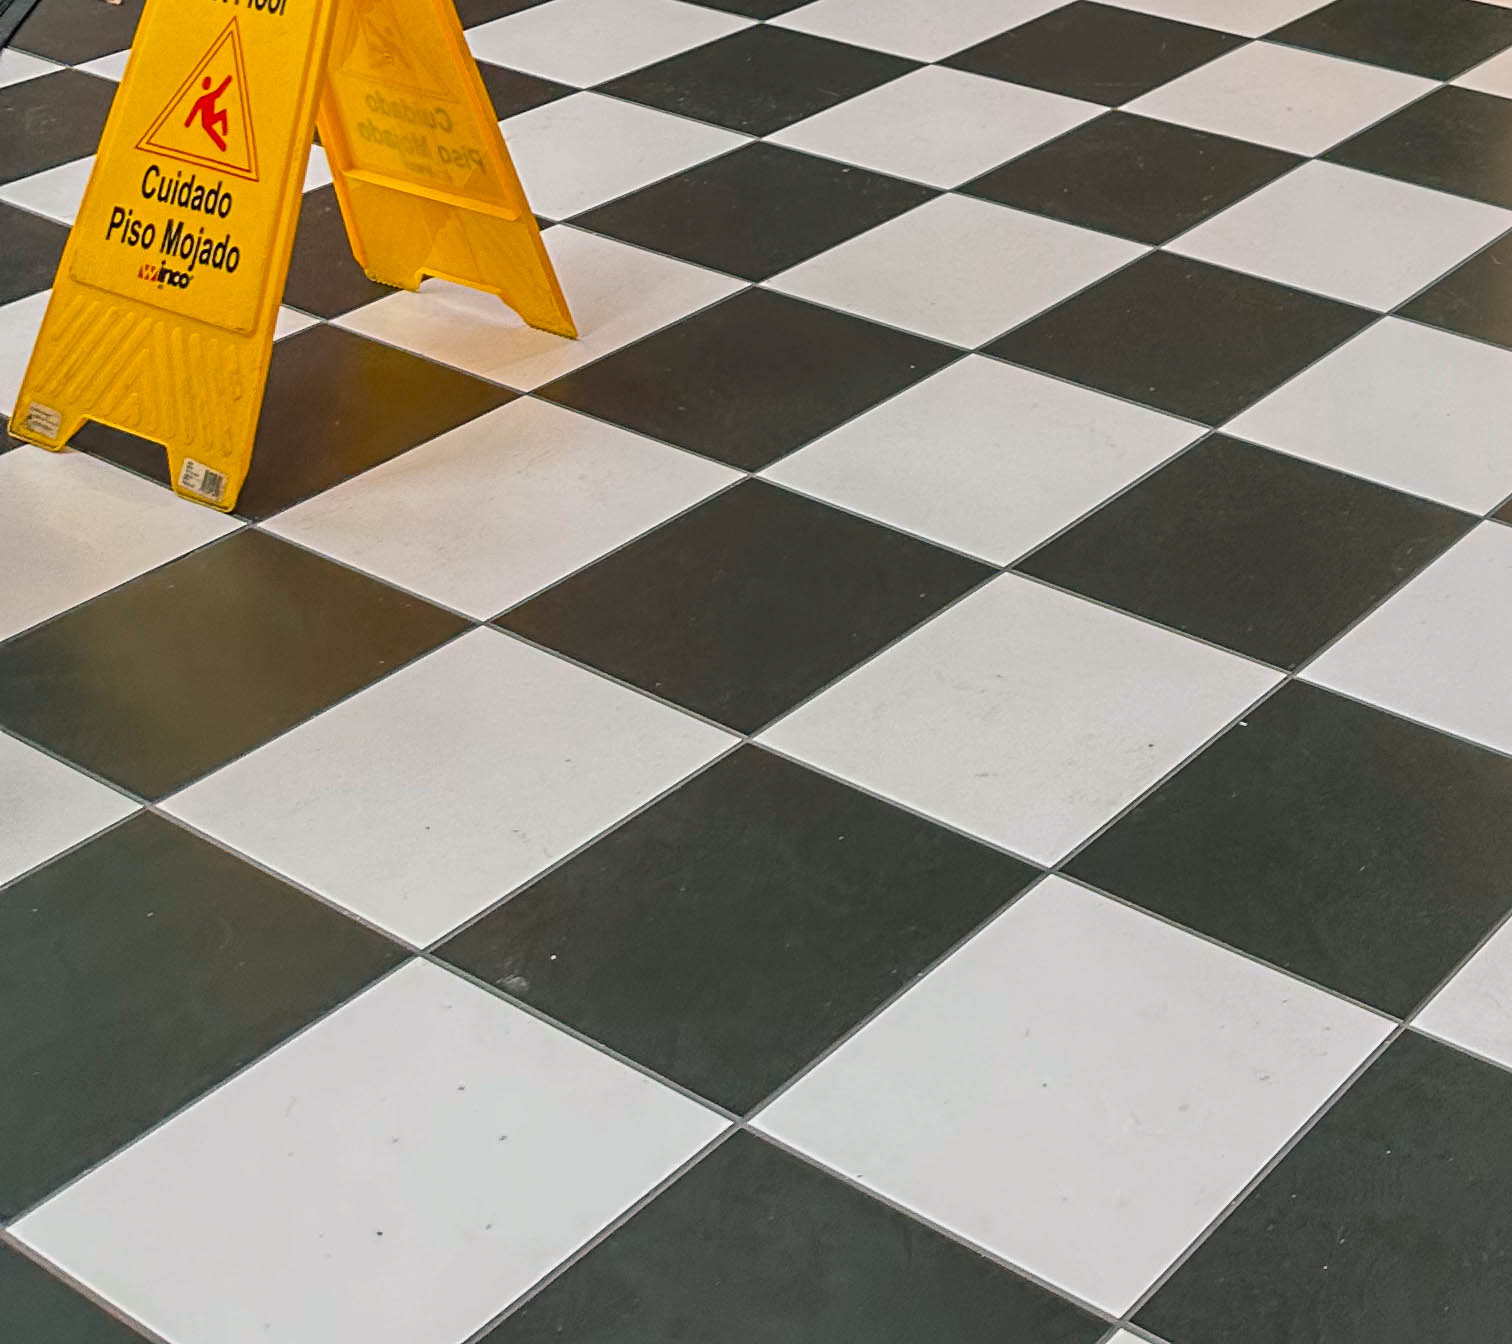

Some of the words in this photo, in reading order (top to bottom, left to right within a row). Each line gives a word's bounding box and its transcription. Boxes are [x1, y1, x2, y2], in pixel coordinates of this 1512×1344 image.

[141, 164, 233, 219] Cuidado
[106, 206, 156, 250] Piso
[160, 218, 240, 274] Mojado
